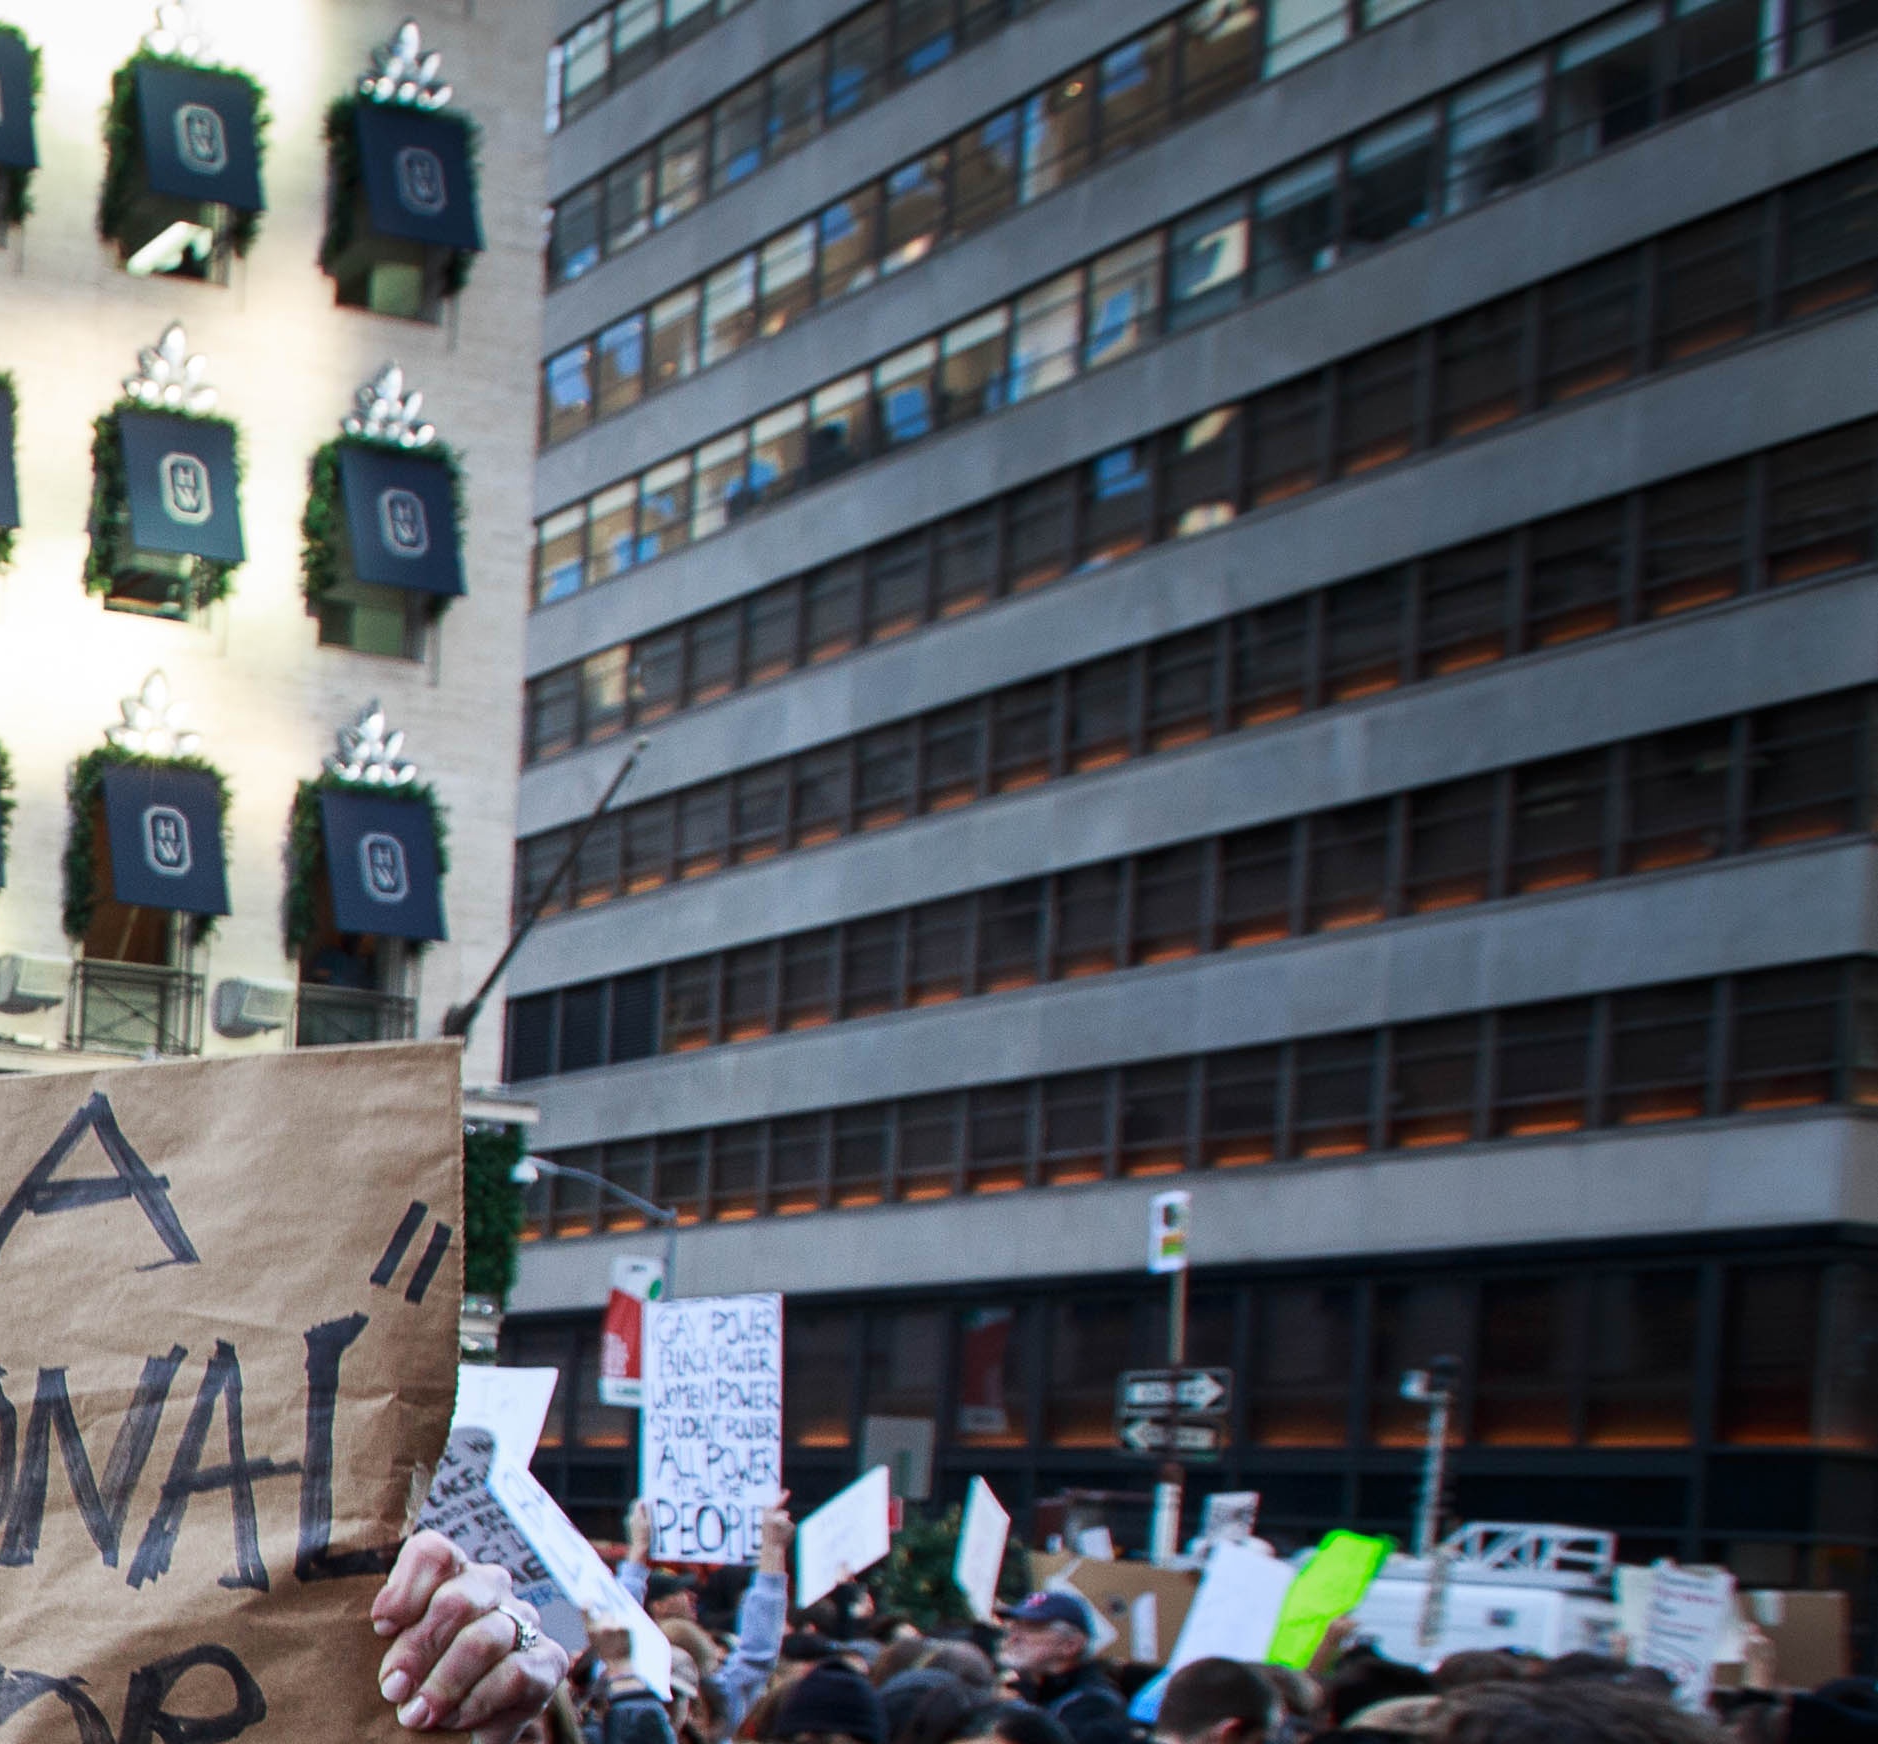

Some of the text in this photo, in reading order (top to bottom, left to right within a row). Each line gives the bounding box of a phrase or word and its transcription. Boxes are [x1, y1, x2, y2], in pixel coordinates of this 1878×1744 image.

[711, 1309, 778, 1345] POWER
[659, 1348, 714, 1377] BLACK
[717, 1348, 777, 1376] POWER
[653, 1381, 713, 1410] WOMEN
[717, 1378, 781, 1410] POWER
[650, 1414, 780, 1441] STUDENT POWER
[656, 1442, 780, 1485] ALL POWER
